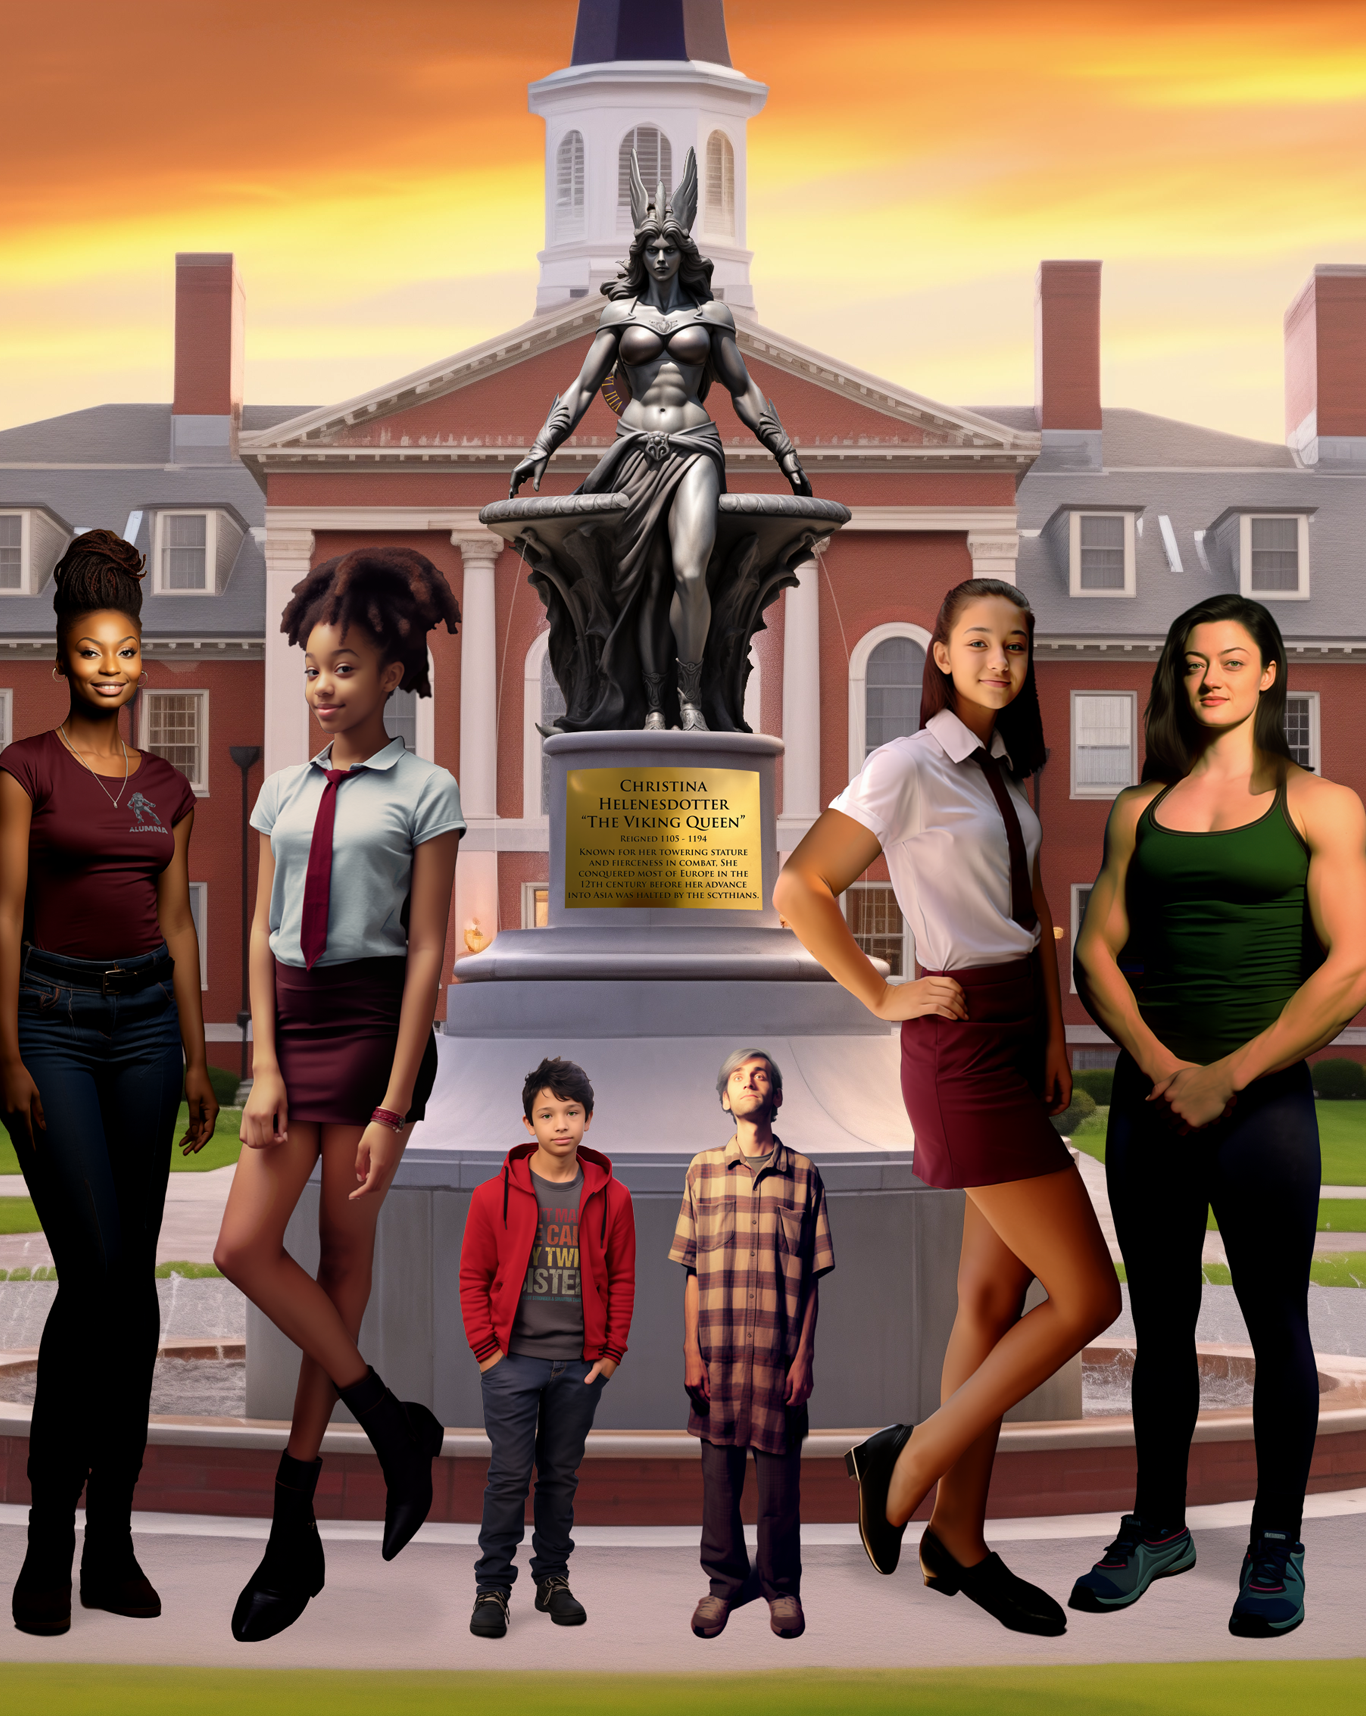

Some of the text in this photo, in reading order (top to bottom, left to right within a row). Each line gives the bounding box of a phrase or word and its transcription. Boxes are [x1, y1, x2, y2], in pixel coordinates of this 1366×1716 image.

[620, 779, 708, 793] CHRISTINA
[599, 797, 730, 811] HELENESDOTTER
[581, 814, 746, 832] “THE VIKING QUEEN”
[129, 825, 168, 835] ALUMNA
[620, 834, 658, 843] REIGNED
[661, 834, 680, 843] 1105
[688, 834, 707, 843] 1194
[579, 848, 748, 856] KNOWN FOR HER TOWERING STATURE
[589, 859, 610, 867] AND
[612, 859, 664, 867] FIERCENESS
[666, 859, 677, 867] IN
[720, 858, 738, 867] SHE
[578, 870, 749, 879] CONQUERED MOST OF EUROPE IN THE
[581, 880, 747, 889] 12TH CENTURY BEFORE HER ADVANCE
[567, 891, 591, 899] INTO
[593, 891, 614, 899] ASIA
[615, 891, 634, 899] WAS
[707, 891, 760, 899] SCYTHIANS.
[535, 1224, 578, 1246] E CAL
[532, 1247, 580, 1267] Y TWI
[522, 1268, 581, 1295] ISTE
